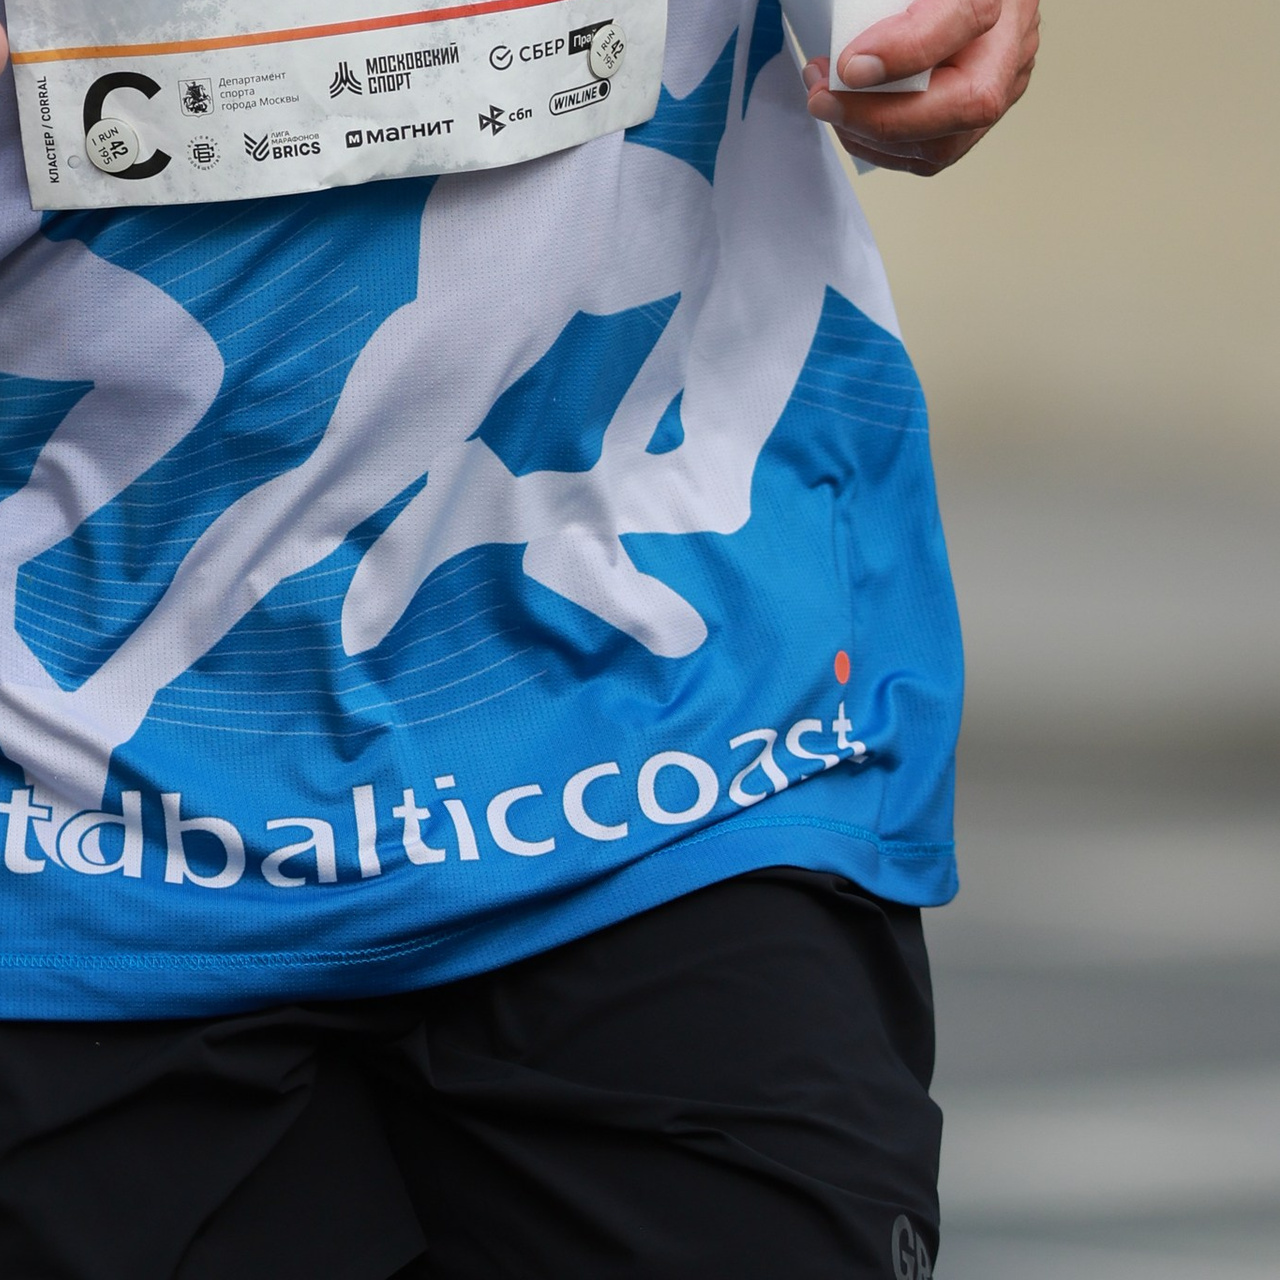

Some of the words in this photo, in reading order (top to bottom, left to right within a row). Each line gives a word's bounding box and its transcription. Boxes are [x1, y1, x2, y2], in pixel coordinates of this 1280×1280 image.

[600, 29, 616, 51] RUN
[610, 39, 625, 60] 42
[365, 42, 460, 76] МОСКОВСКИЙ
[519, 38, 565, 62] СБЕР
[602, 53, 616, 69] 195
[218, 71, 286, 88] Департамент
[368, 72, 412, 95] СПОРТ
[36, 75, 52, 122] CORRAL
[219, 88, 256, 100] спорта
[221, 99, 257, 112] города
[259, 95, 300, 107] Москвы
[554, 86, 598, 111] WINLINE
[508, 106, 533, 122] сбп
[98, 126, 120, 143] RUN
[270, 130, 290, 139] ЛИГА
[270, 133, 320, 146] МАРАФОНОВ
[43, 131, 60, 184] КЛАСТЕР
[97, 146, 114, 165] 195
[108, 139, 129, 160] 42
[272, 141, 322, 160] BRICS
